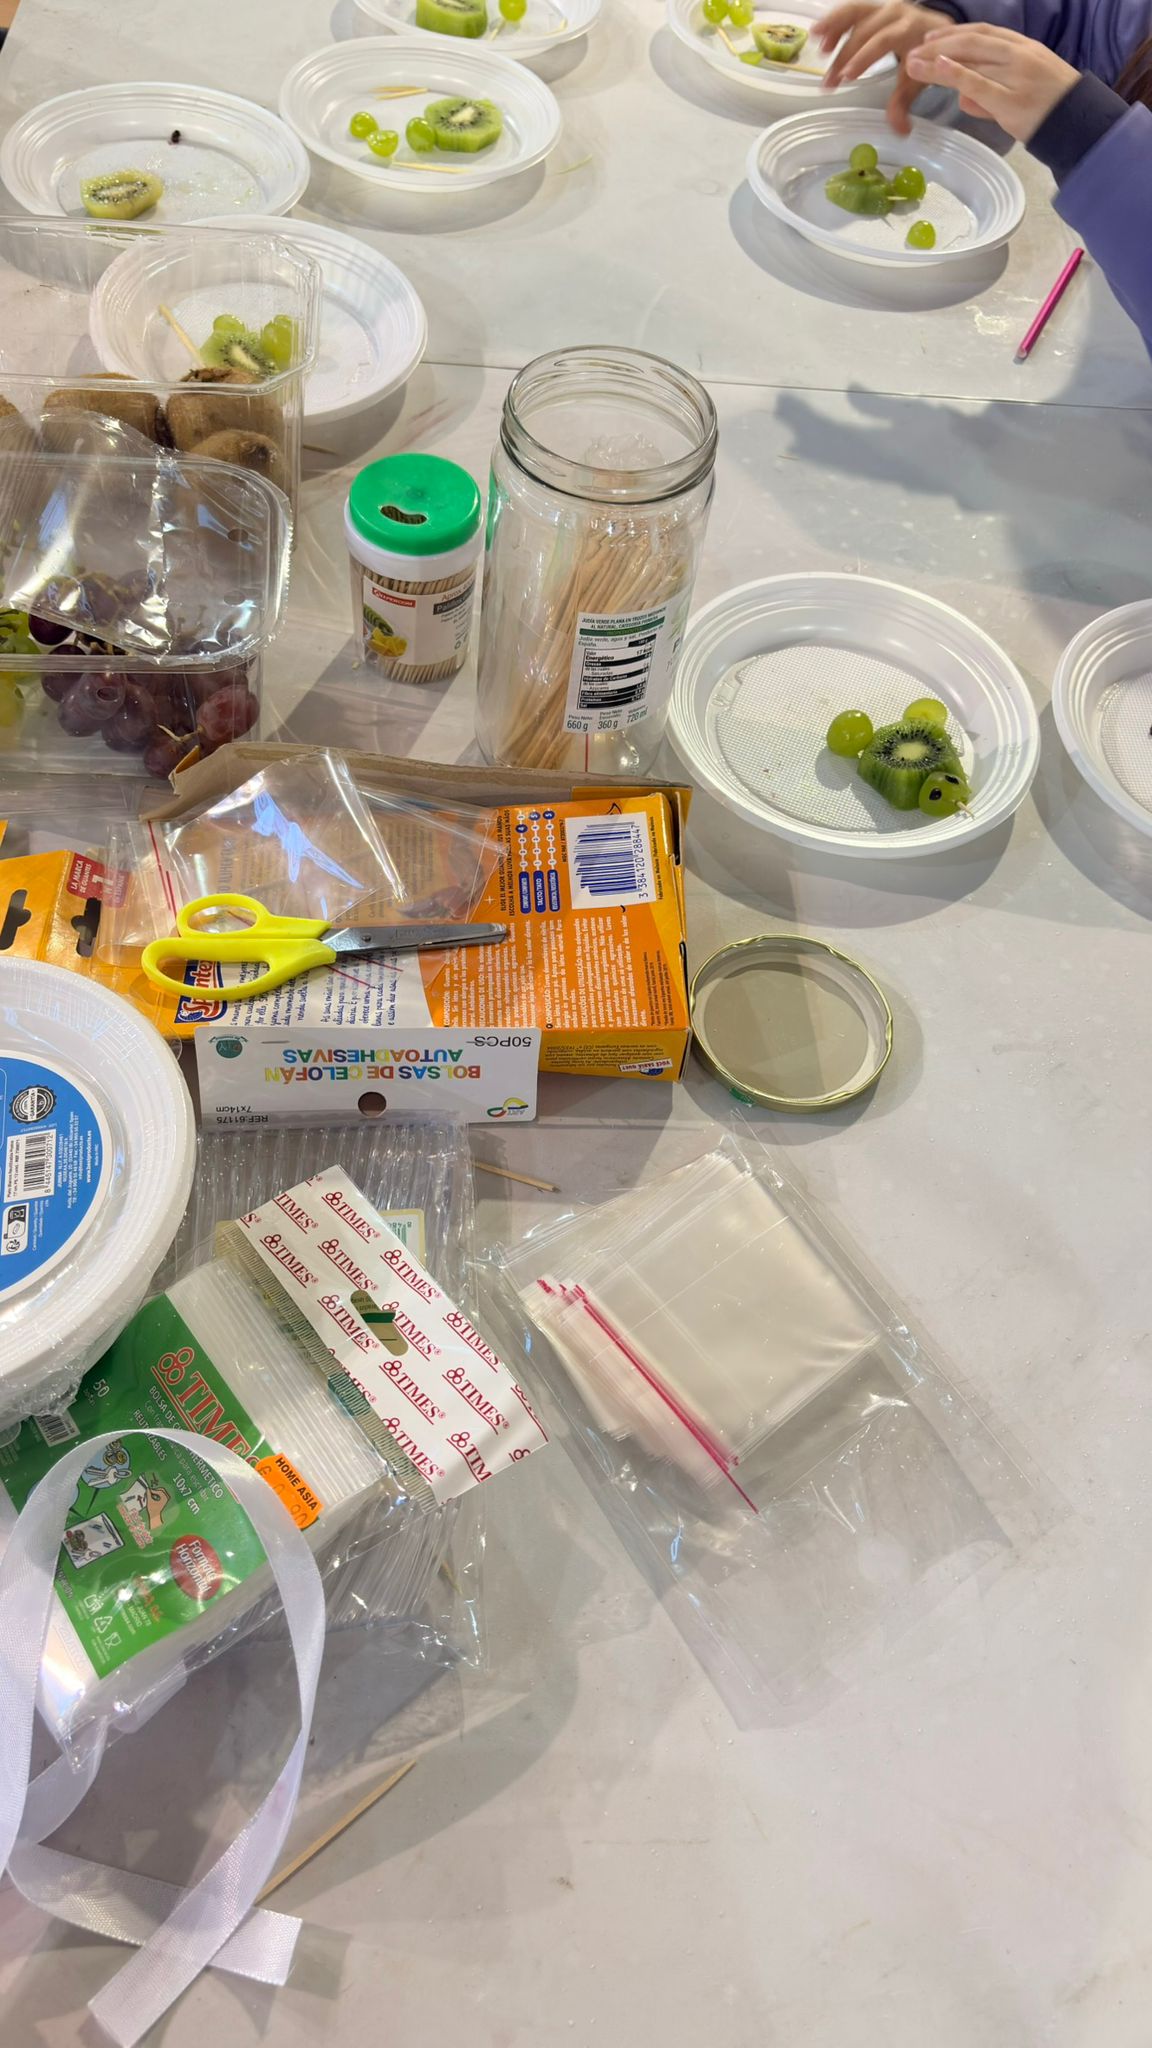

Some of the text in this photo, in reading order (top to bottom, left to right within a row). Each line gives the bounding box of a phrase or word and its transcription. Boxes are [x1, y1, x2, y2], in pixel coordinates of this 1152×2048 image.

[585, 655, 615, 663] Energético
[567, 720, 589, 732] 660 g
[598, 719, 619, 730] 360 g
[72, 860, 83, 890] LA MARCA
[80, 864, 92, 894] DE GUANTES
[441, 990, 452, 1025] COMPOSICIÓN:
[542, 988, 554, 1024] COMPOSIÇÃO:
[281, 1048, 464, 1064] AUTOADHESIVAS
[474, 1036, 533, 1048] 50PCS
[263, 1064, 481, 1085] BOLSAS DE CELOFÁN
[29, 1090, 37, 1121] GARANTÍA
[215, 1105, 252, 1114] 7x14cm
[215, 1113, 269, 1123] REF:61175
[146, 1384, 171, 1413] BOLSA
[163, 1409, 177, 1424] DE
[168, 1470, 194, 1499] 10x7
[184, 1495, 202, 1515] cm
[275, 1456, 319, 1511] HOME ASIA
[175, 1543, 213, 1593] Horizontal
